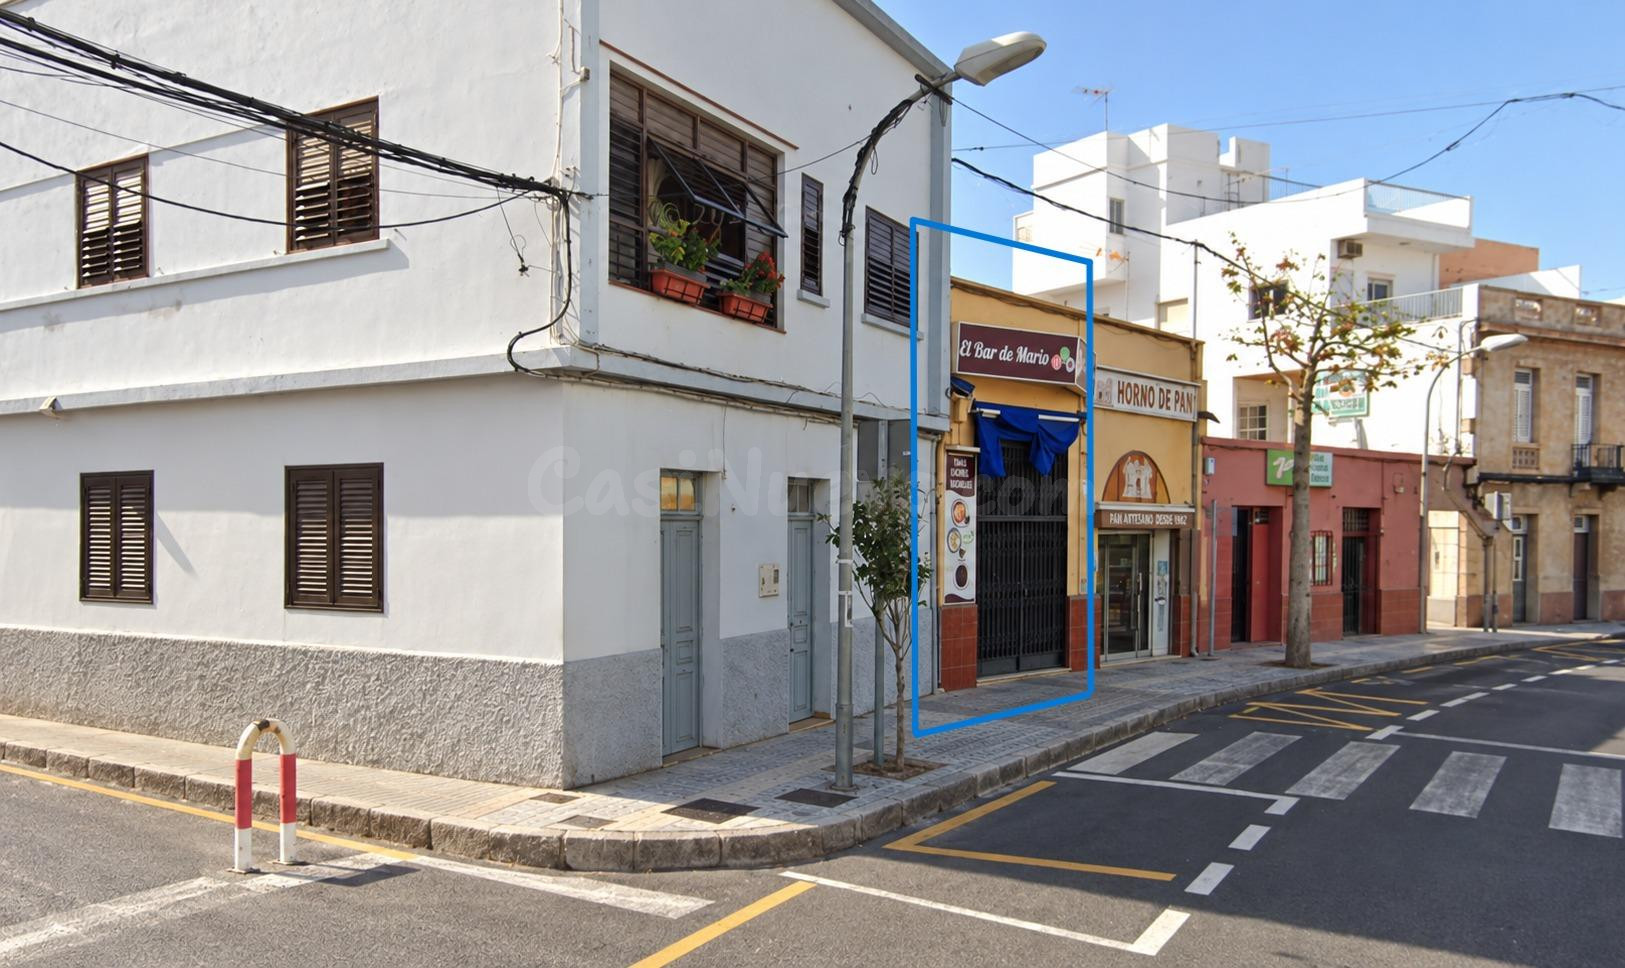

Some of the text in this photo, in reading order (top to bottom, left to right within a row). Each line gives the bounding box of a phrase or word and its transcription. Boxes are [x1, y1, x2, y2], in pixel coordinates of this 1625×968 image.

[960, 339, 1050, 366] El Bar de Mario
[1117, 380, 1193, 414] HORNO DE PAN
[1109, 512, 1122, 525] PAN
